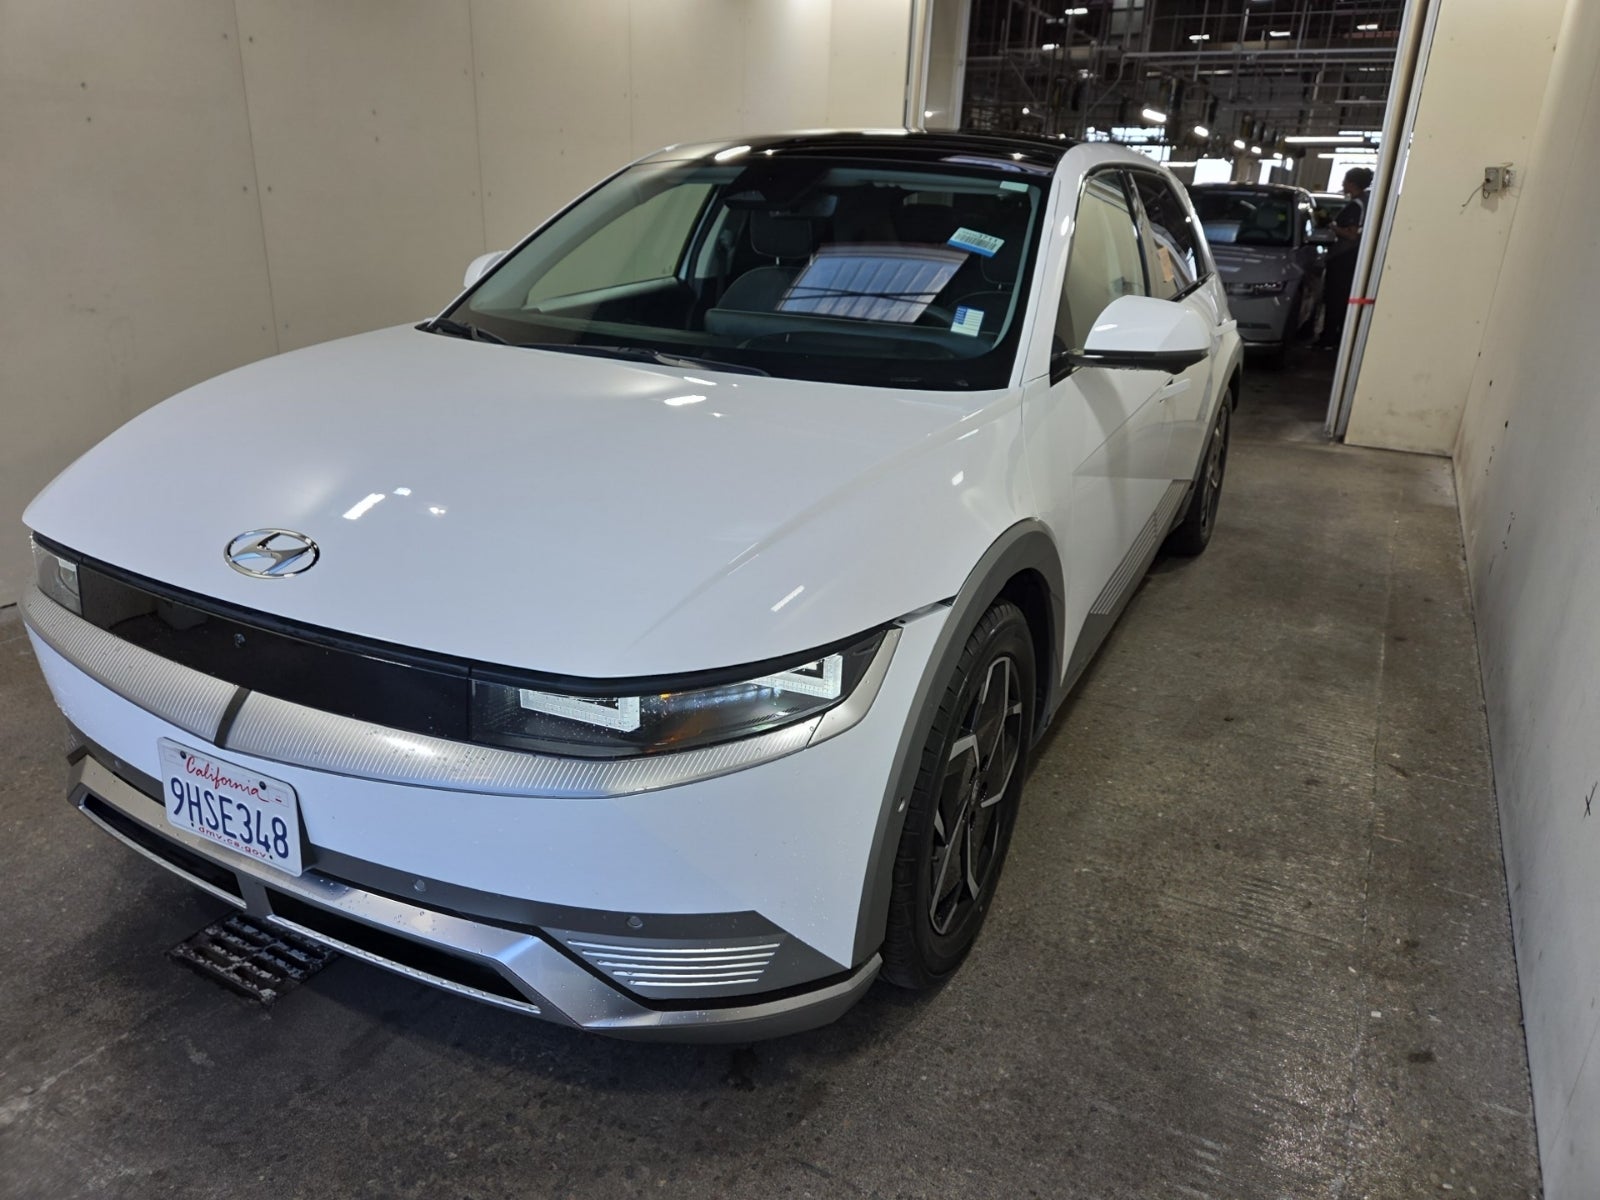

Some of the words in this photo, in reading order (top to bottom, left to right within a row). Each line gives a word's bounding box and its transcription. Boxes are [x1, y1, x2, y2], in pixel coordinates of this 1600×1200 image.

[186, 755, 269, 803] California
[171, 777, 289, 859] 9HSE348
[198, 826, 266, 858] dmv.ca.gov
